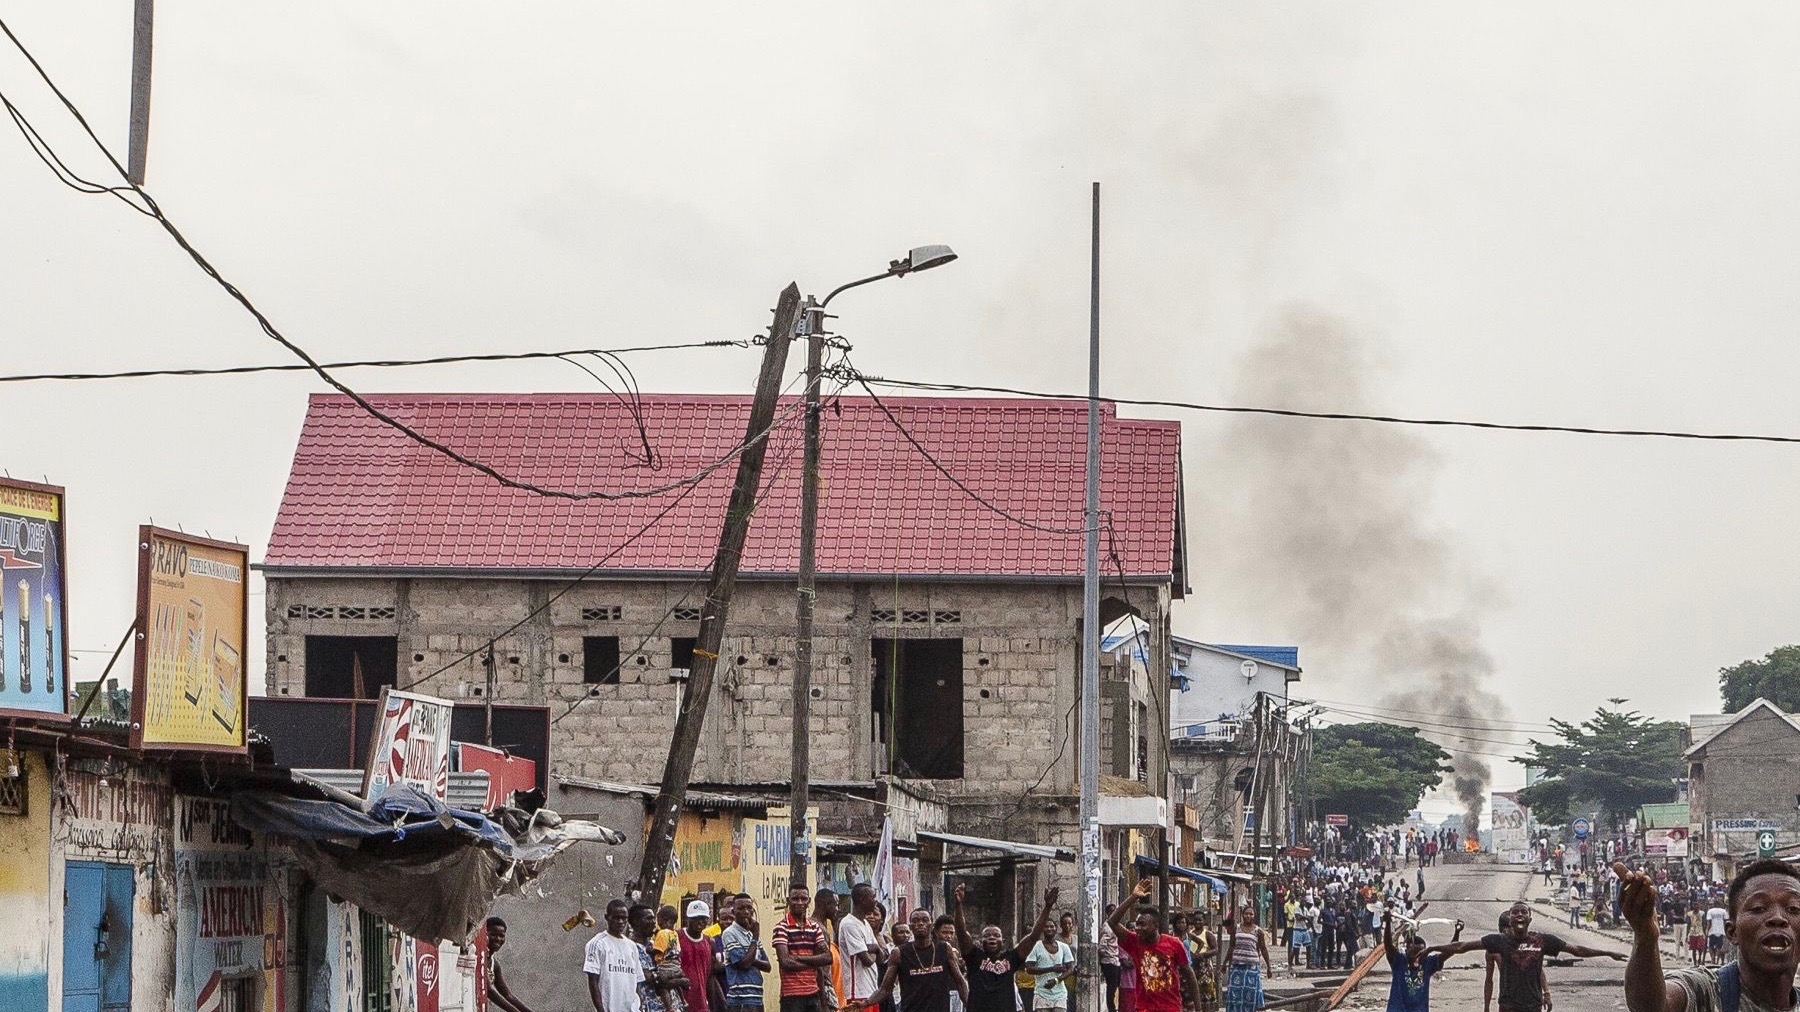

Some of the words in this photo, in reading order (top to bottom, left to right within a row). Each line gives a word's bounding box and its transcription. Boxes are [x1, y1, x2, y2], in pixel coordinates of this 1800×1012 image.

[152, 540, 187, 578] BRAVO
[1715, 820, 1757, 829] PRESSING
[755, 824, 812, 866] PHARME
[200, 886, 264, 937] AMERICAN
[214, 941, 243, 968] WATER
[422, 959, 436, 979] itel
